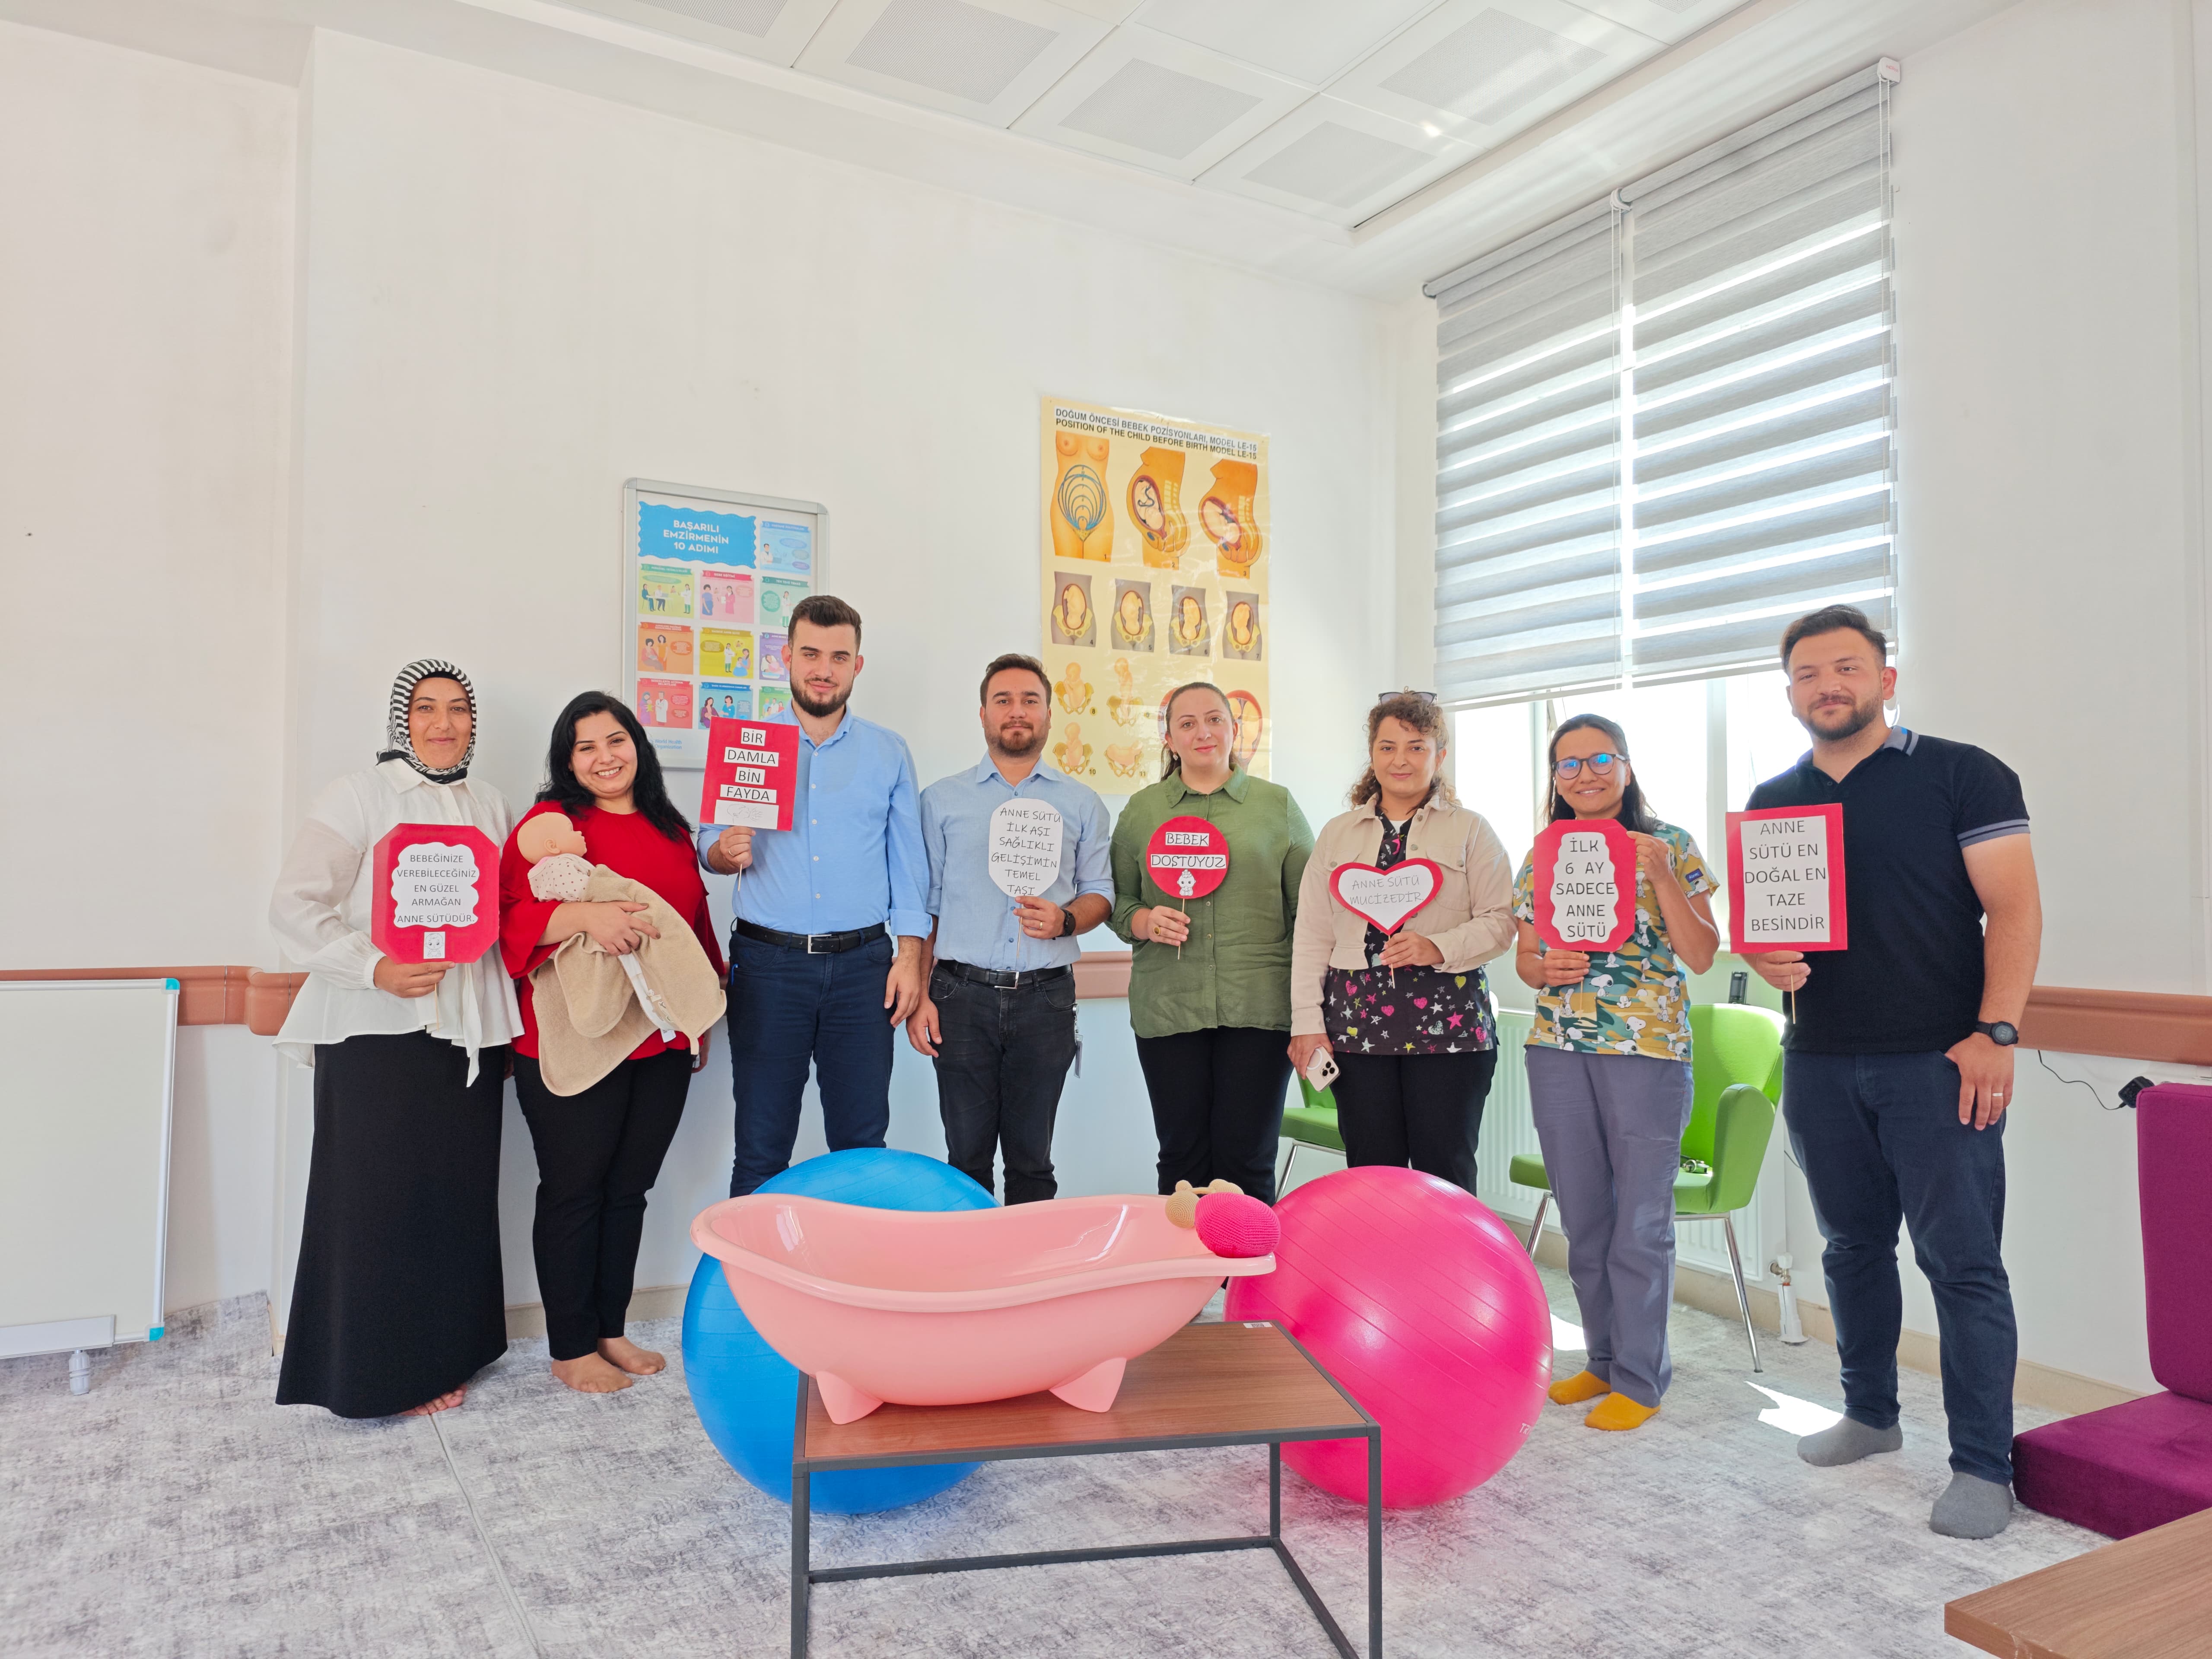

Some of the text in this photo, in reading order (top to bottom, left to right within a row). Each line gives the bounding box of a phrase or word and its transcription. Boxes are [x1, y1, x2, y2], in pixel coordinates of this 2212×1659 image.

[1056, 409, 1087, 421] DOĞUM
[1089, 413, 1119, 426] ÖNCESİ
[1122, 420, 1148, 432] BEBEK
[1210, 437, 1235, 448] MODEL
[1238, 442, 1256, 451] LE-15
[1056, 418, 1256, 459] POSITION OF THE CHILD BEFORE BIRTH MODEL LE-15
[674, 520, 719, 533] BAŞARILI
[663, 529, 729, 544] EMZİRMENİN
[674, 542, 718, 553] 10 ADIMI
[743, 730, 763, 744] BİR
[728, 750, 775, 764] DAMLA
[739, 769, 760, 783] BİN
[727, 787, 769, 801] FAYDA
[1000, 807, 1060, 822] ANNE SÜTÜ
[1007, 822, 1051, 836] İLK AŞI
[1760, 820, 1805, 835] ANNE
[999, 836, 1054, 852] SAĞLIKLI
[1166, 833, 1208, 845] BEBEK
[1570, 837, 1599, 852] İLK
[410, 853, 463, 862] BEBEĞİNİZE
[1749, 842, 1818, 859] SÜTÜ EN
[992, 852, 1057, 868] GELİŞİMİN
[1152, 855, 1225, 868] DOSTUYUZ
[397, 868, 476, 877] VEREBİLECEĞİNİZ
[1005, 869, 1040, 880] TEMEL
[1566, 862, 1604, 874] 6 AY
[1352, 875, 1420, 890] ANNE SÜTÜ
[1745, 867, 1826, 884] DOĞAL EN
[429, 884, 459, 892] GÜZEL
[1007, 885, 1035, 896] TAŞI
[1556, 882, 1615, 894] SADECE
[411, 897, 461, 906] ARMAĞAN
[1350, 892, 1424, 905] MUCİZEDİR.
[1767, 893, 1805, 906] TAZE
[427, 913, 474, 922] SÜTÜDÜR.
[1567, 905, 1605, 916] ANNE
[1567, 922, 1605, 937] SÜTÜ
[1751, 914, 1824, 931] BESİNDİR
